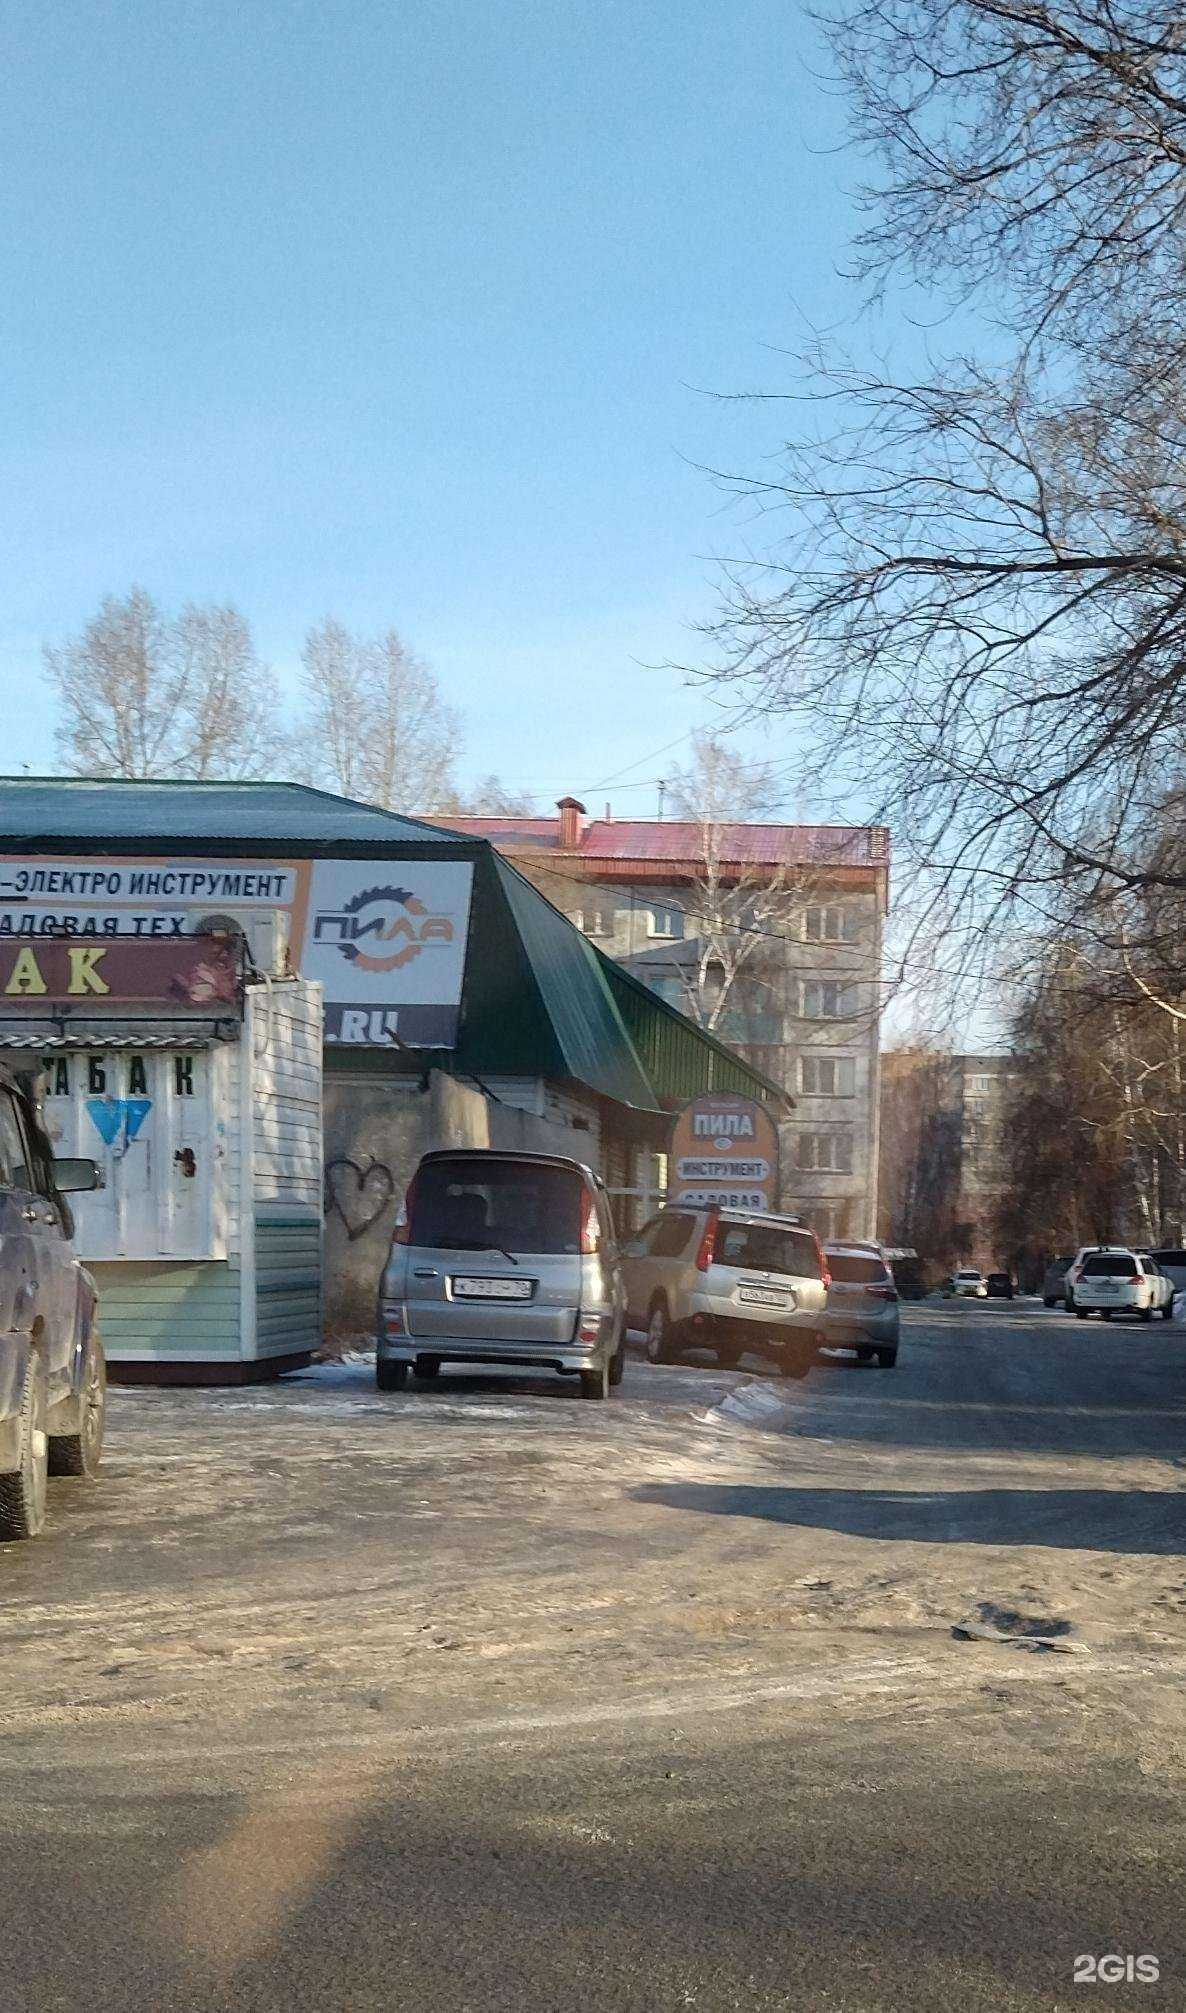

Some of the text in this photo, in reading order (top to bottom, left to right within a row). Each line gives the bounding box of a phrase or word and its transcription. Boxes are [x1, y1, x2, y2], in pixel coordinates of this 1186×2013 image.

[129, 873, 288, 897] ИНСТРУМЕНТ
[313, 915, 454, 942] ПИЛА
[693, 1113, 755, 1136] ПИЛА
[682, 1162, 763, 1176] ИНСТРУМЕНТ
